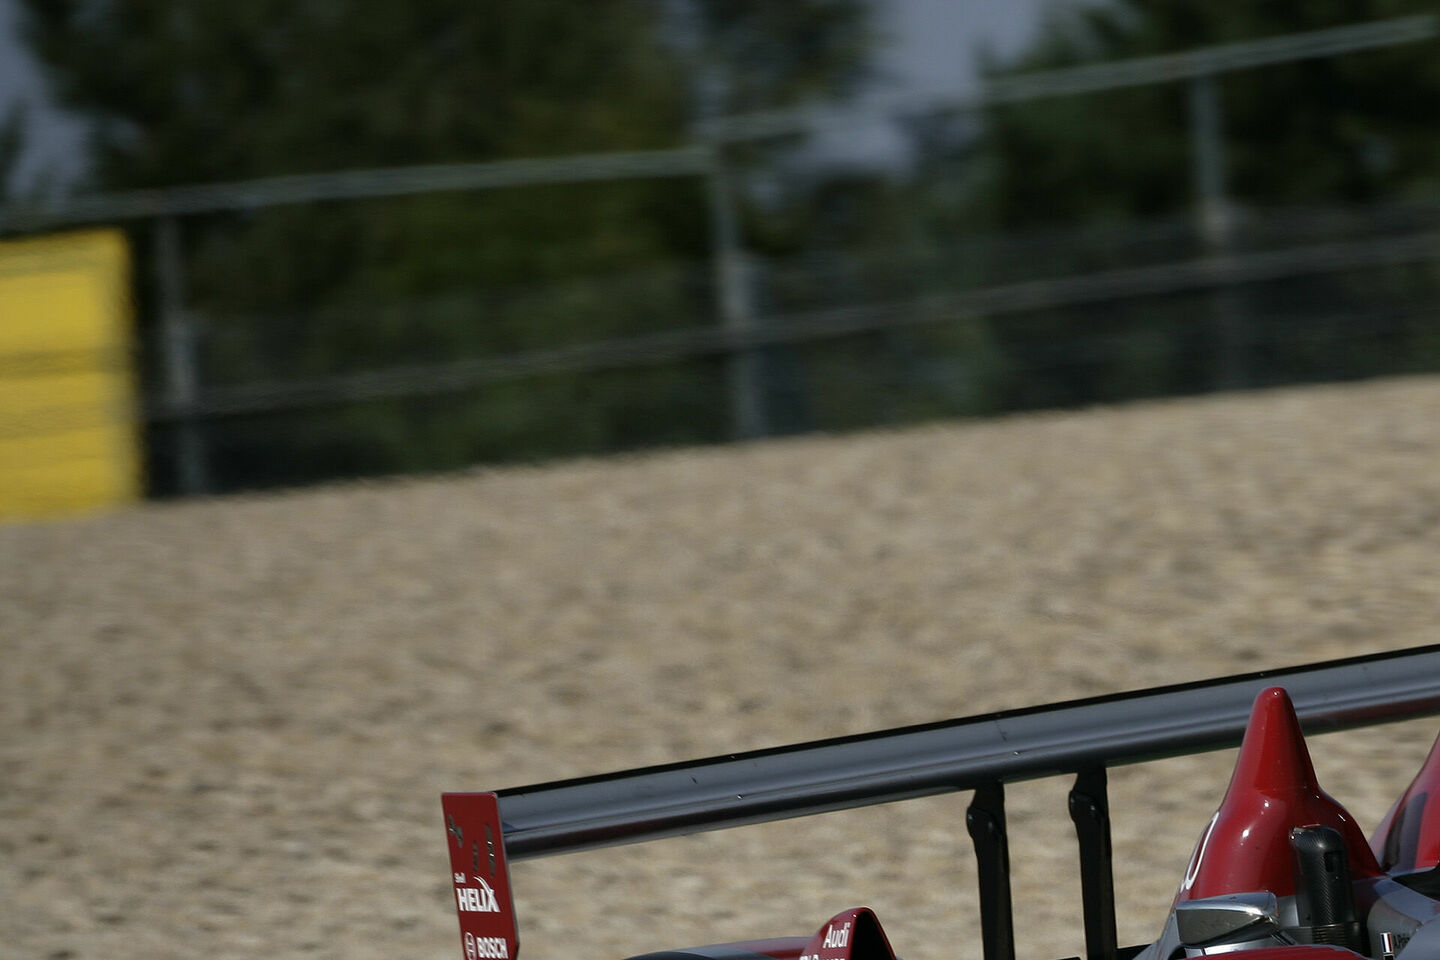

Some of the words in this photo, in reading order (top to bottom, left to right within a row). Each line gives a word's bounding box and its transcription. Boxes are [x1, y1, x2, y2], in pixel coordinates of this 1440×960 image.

[456, 882, 501, 913] HELIX
[476, 936, 509, 960] BOSCH
[822, 922, 851, 949] Audi
